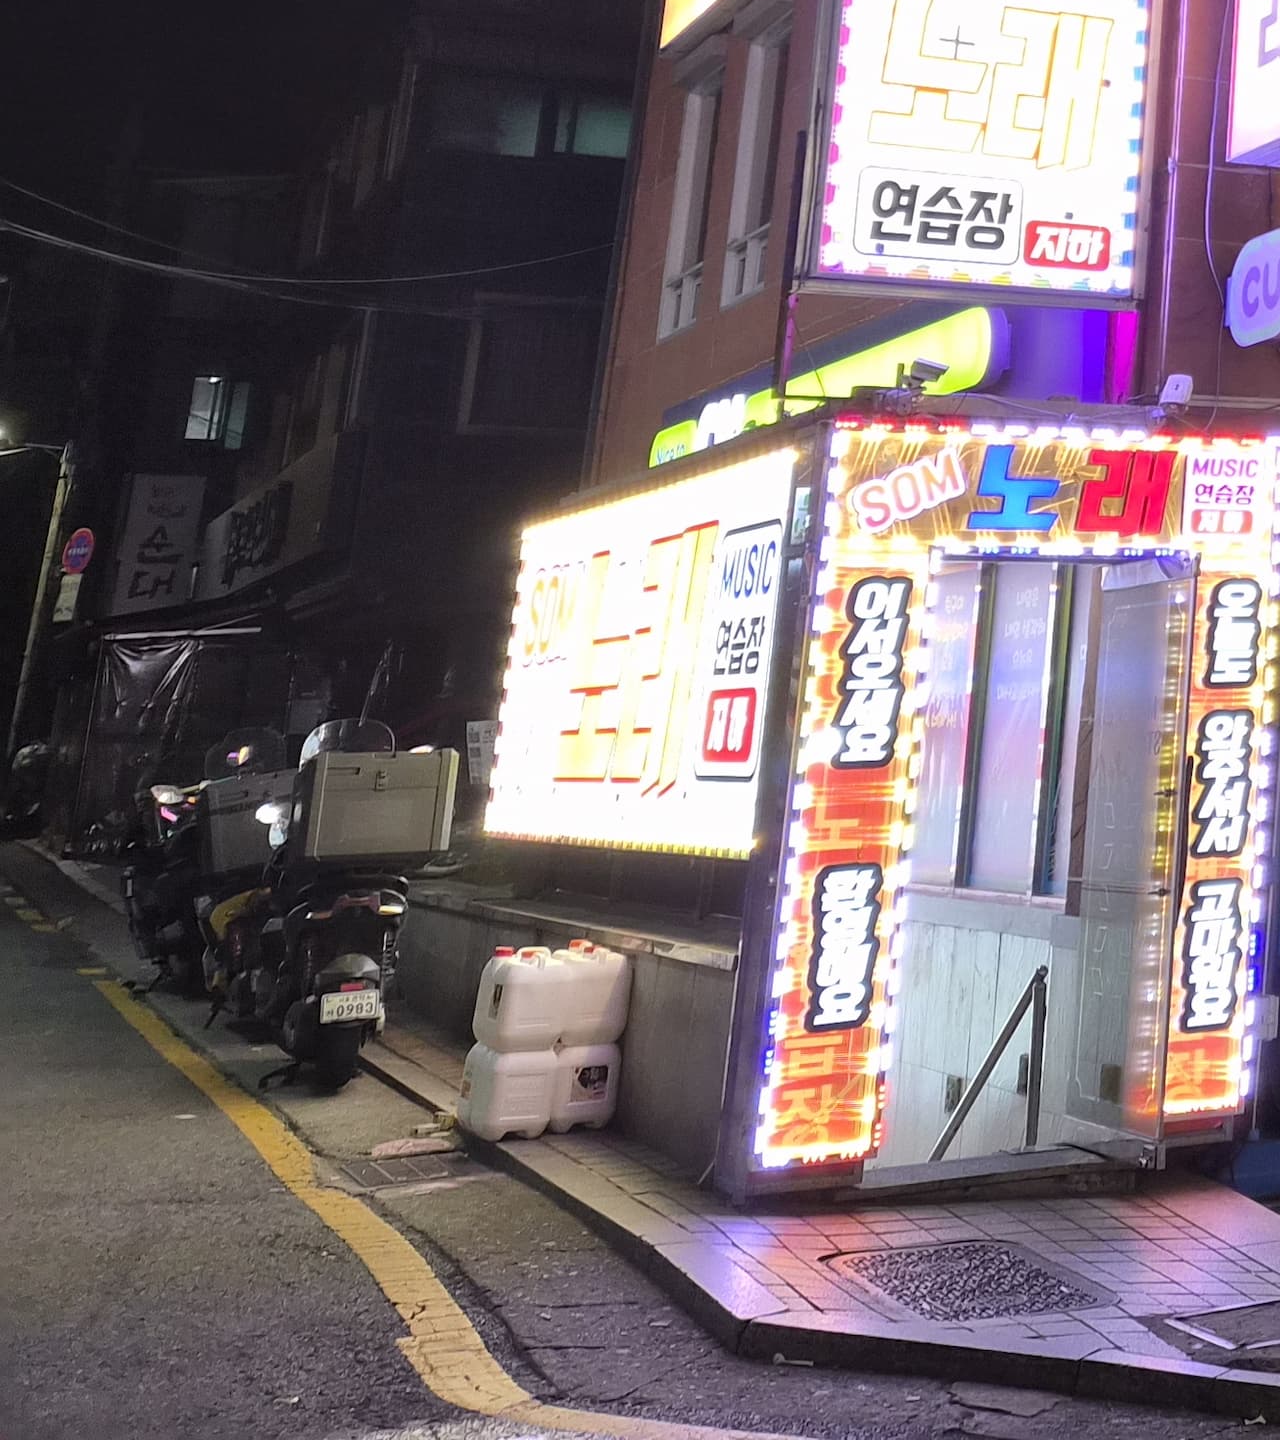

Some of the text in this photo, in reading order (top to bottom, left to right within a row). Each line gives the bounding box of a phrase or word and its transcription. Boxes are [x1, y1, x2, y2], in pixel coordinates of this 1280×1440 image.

[870, 180, 1105, 265] 연습장 지하
[860, 444, 1176, 536] SOM 노래
[1192, 459, 1257, 478] MUSIC
[1194, 483, 1254, 505] 연습장
[721, 541, 776, 599] MUSIC
[553, 520, 719, 798] 노래
[714, 615, 765, 676] 연습장
[840, 581, 906, 763] 어서오세요
[1210, 583, 1257, 684] 오늘도
[708, 697, 749, 752] 지하
[1197, 714, 1248, 854] 와주셔서
[1187, 885, 1239, 1028] 고마워요
[337, 1002, 373, 1017] 0983
